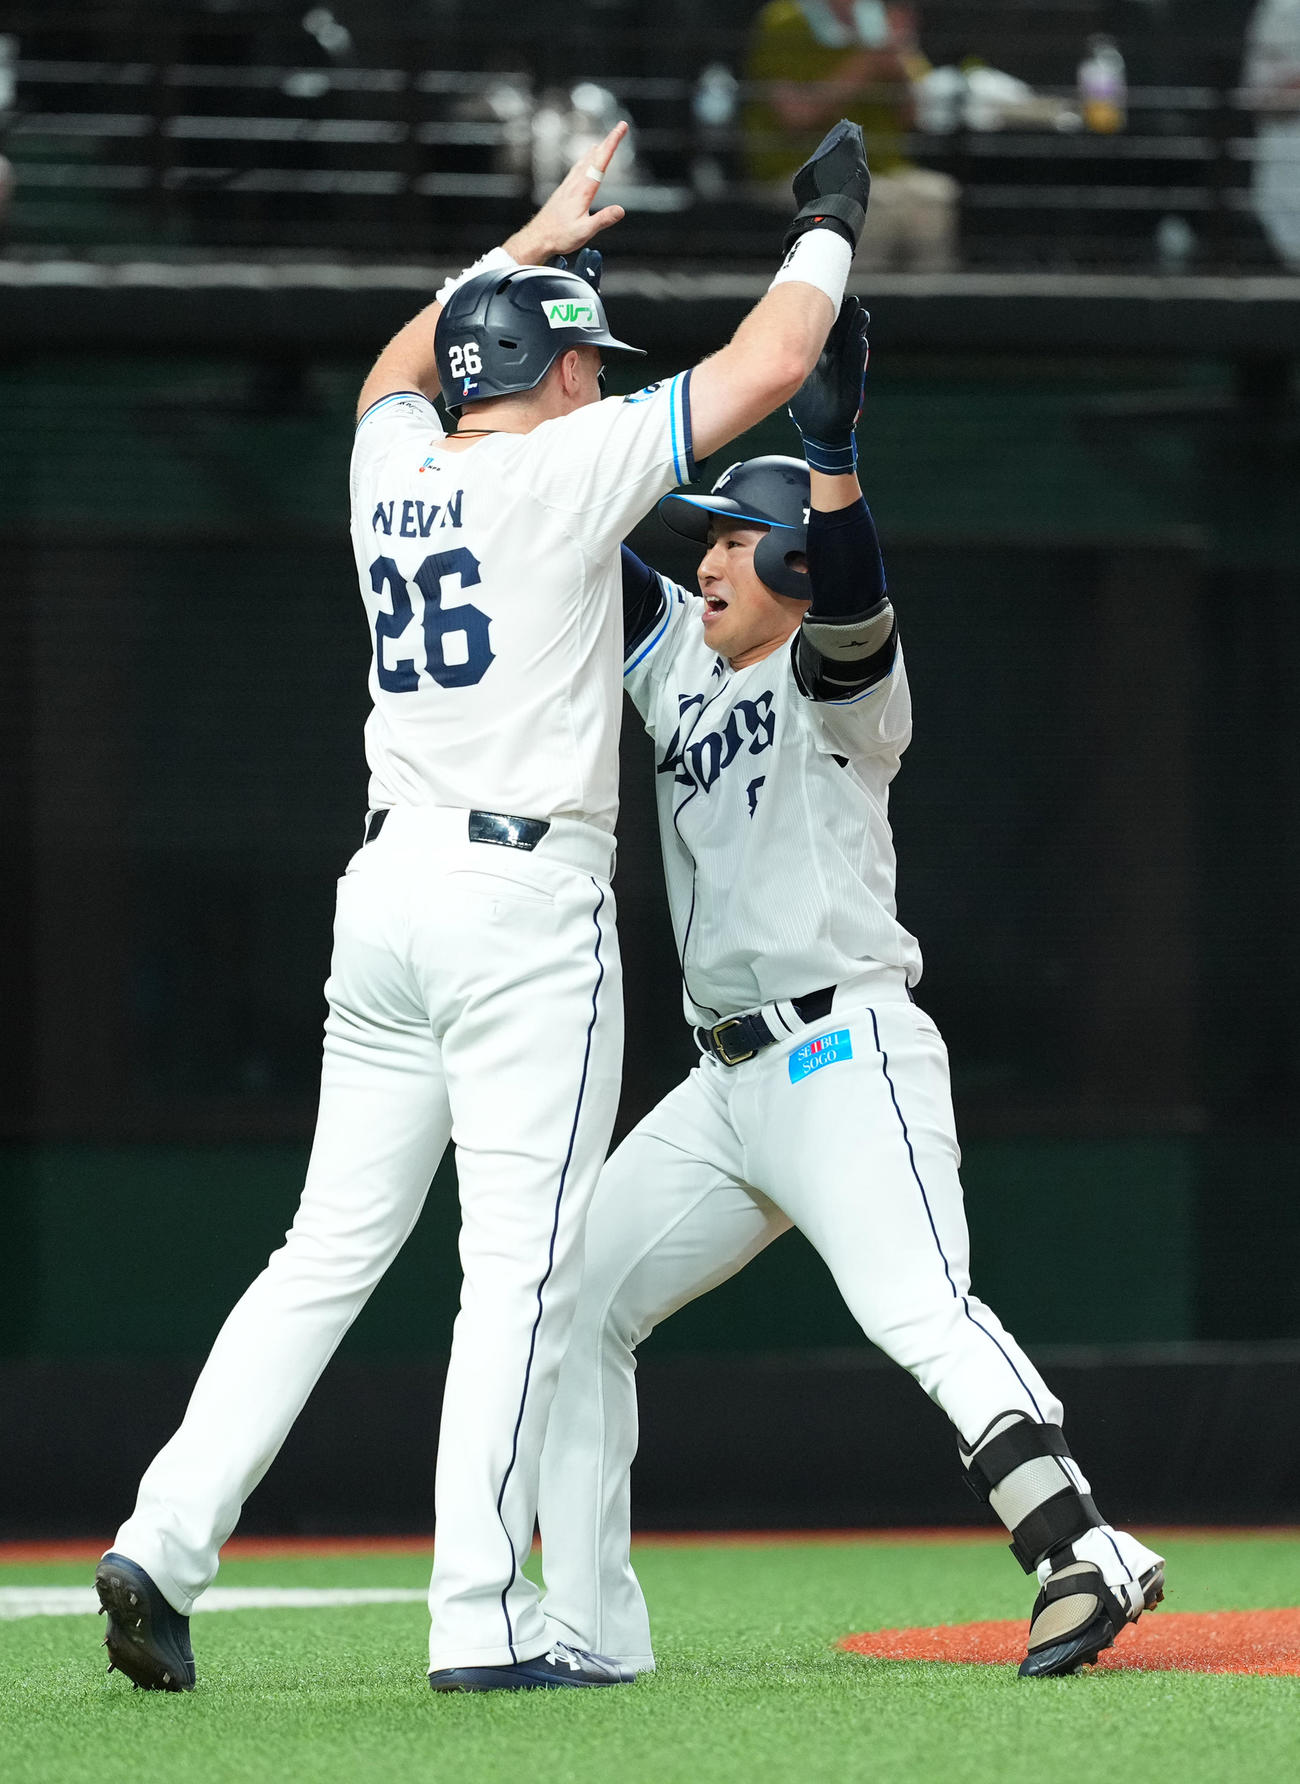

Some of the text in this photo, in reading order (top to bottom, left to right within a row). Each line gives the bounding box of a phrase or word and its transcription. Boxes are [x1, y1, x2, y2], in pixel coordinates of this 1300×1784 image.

[448, 341, 483, 378] 26
[372, 489, 464, 538] NEVN
[369, 546, 496, 693] 26
[798, 1034, 839, 1061] SEIBU
[802, 1050, 837, 1075] SOGO
